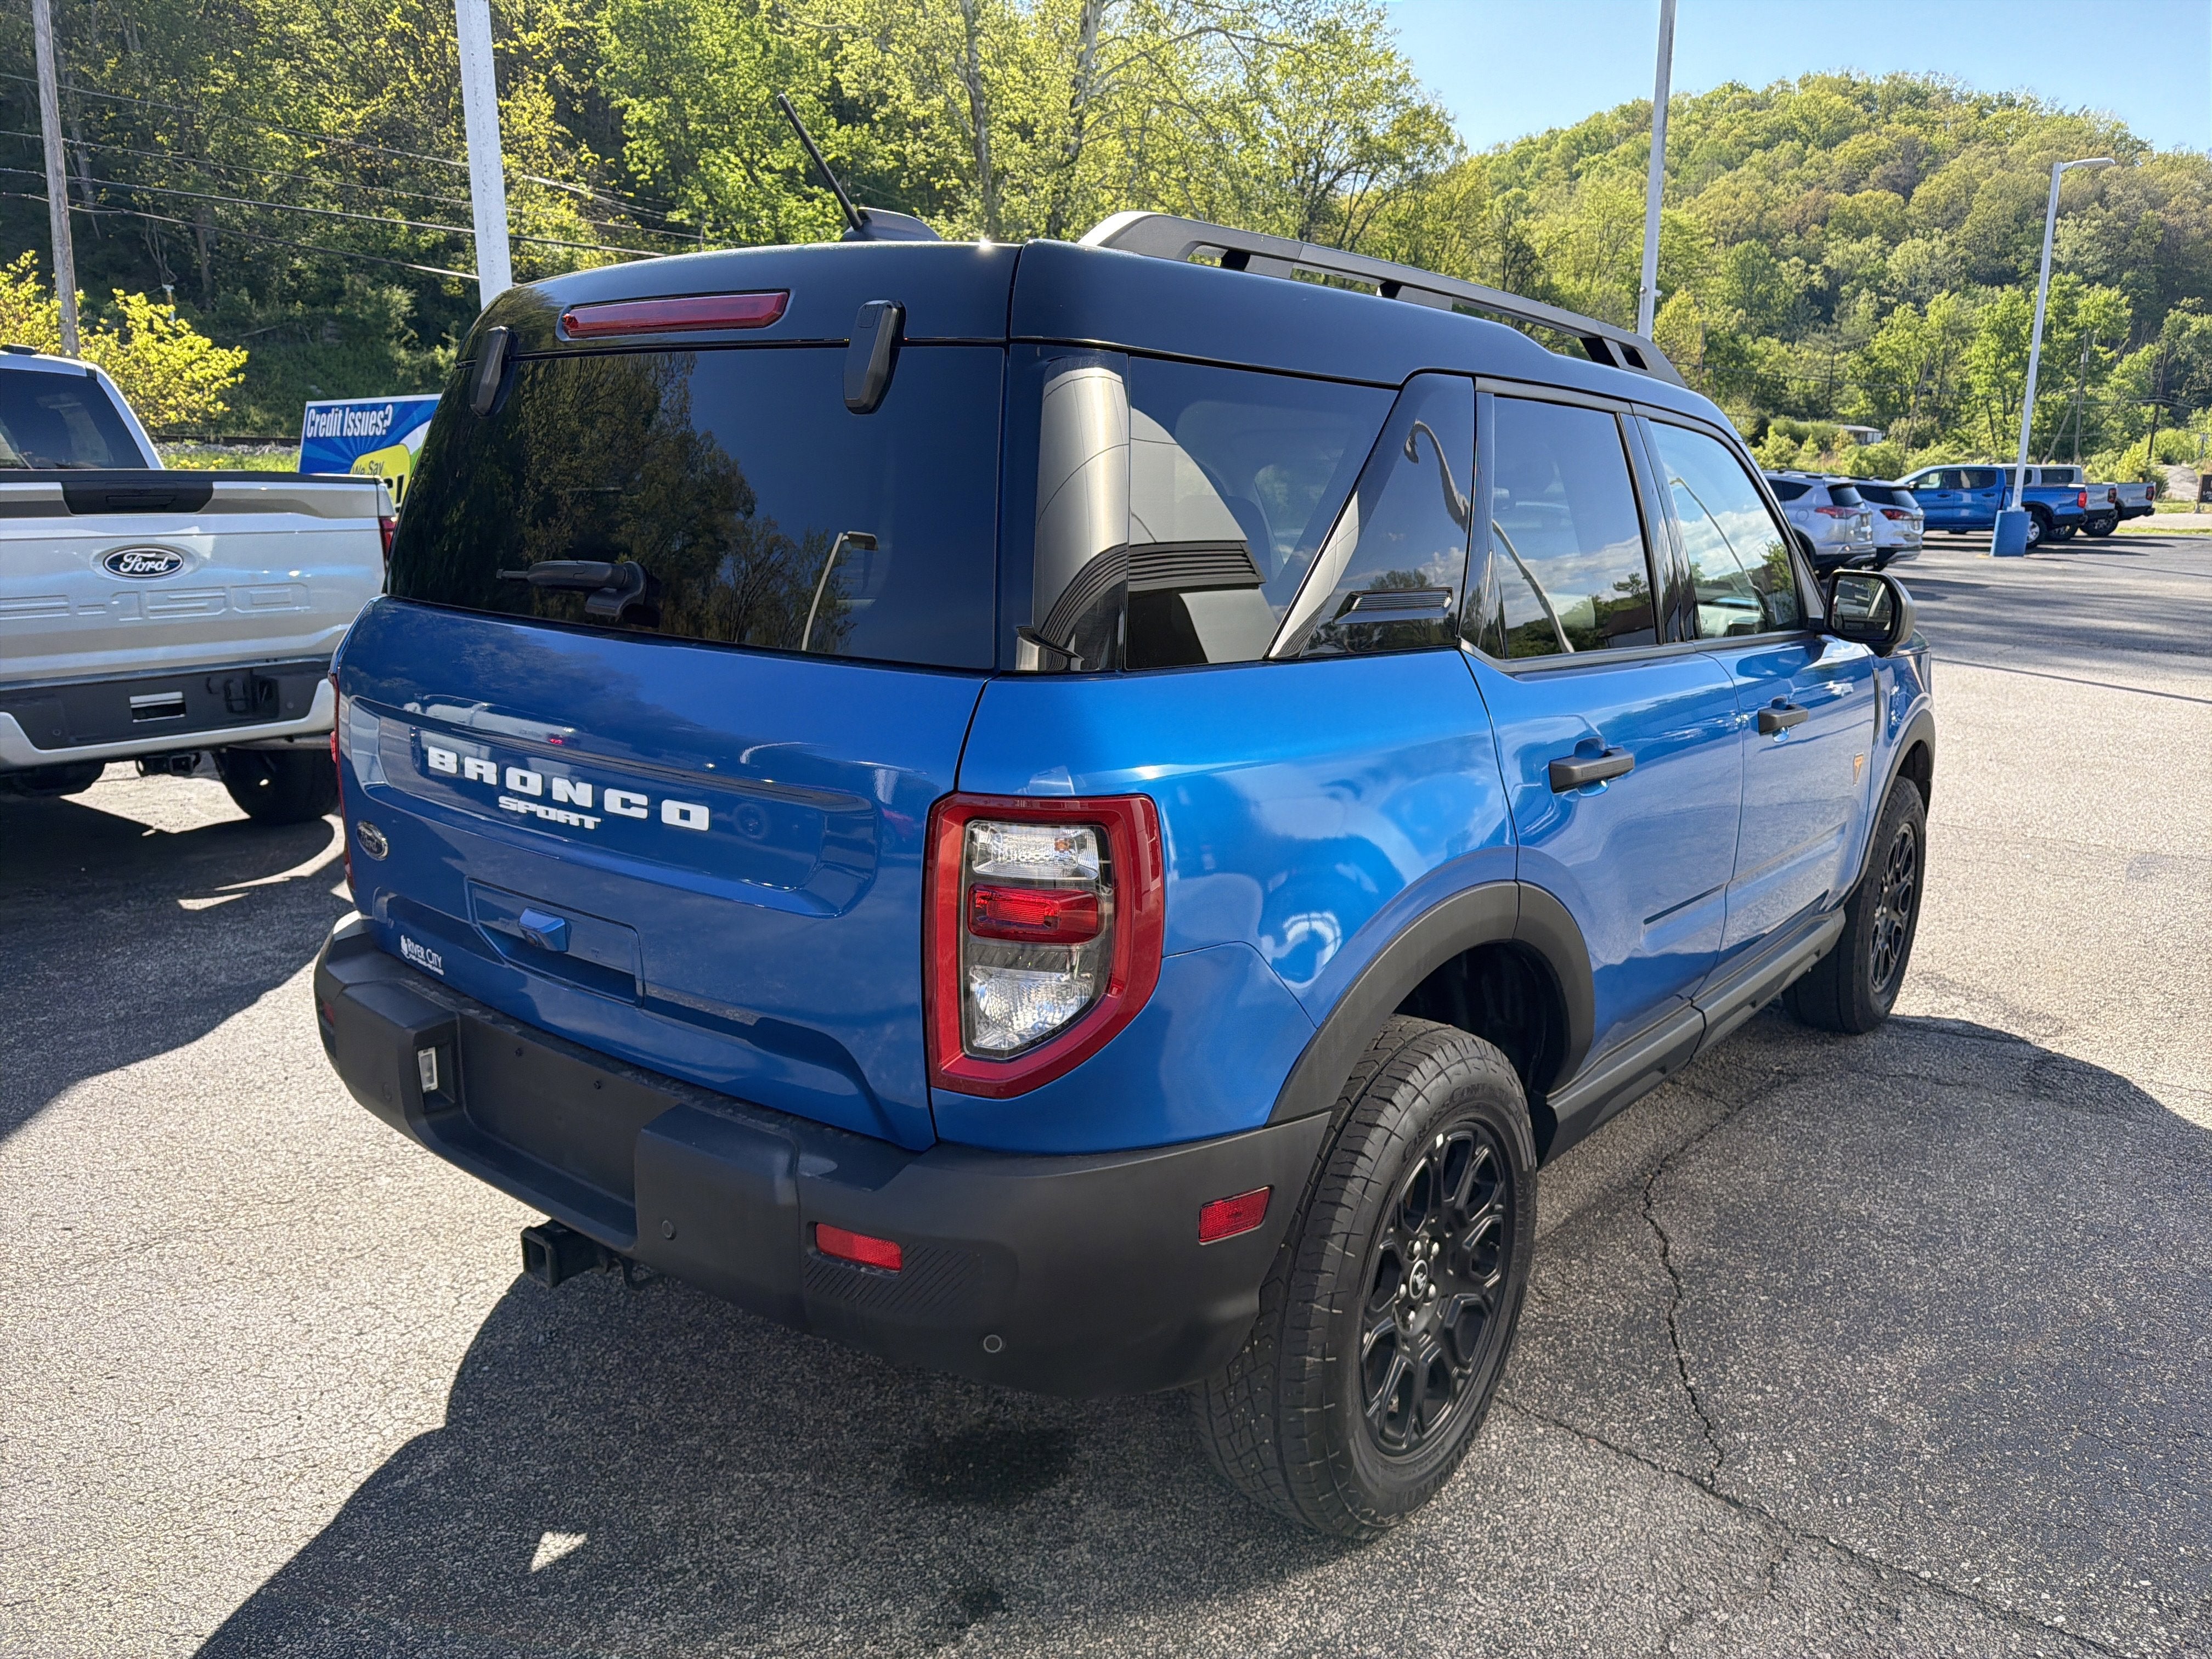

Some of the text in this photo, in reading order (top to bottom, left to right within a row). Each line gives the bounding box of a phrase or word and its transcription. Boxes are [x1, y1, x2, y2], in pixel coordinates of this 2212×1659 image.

[306, 404, 393, 438] Credit Issues?
[368, 460, 385, 476] Say
[119, 552, 170, 572] Ford
[428, 745, 711, 832] BRONCO
[498, 795, 602, 830] SPORT
[407, 938, 426, 961] RIVER
[426, 948, 442, 969] CITY
